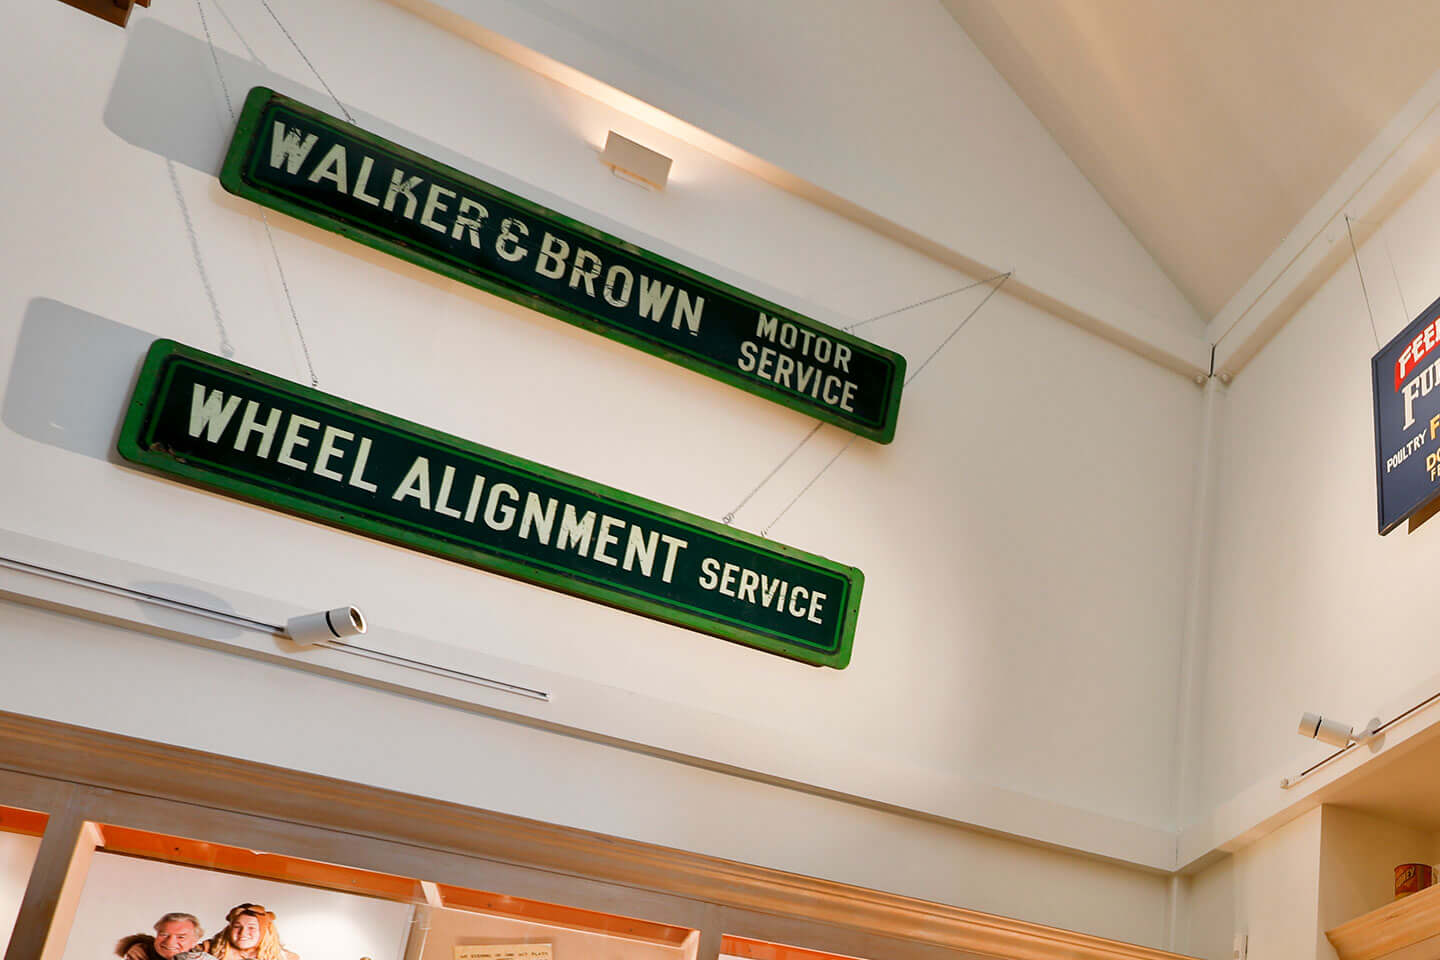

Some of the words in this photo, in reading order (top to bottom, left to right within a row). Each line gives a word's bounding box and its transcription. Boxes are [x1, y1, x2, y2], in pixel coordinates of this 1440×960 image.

[269, 121, 487, 248] WALKER
[494, 217, 529, 263] &
[535, 233, 706, 336] BROWN
[736, 342, 858, 414] SERVICE
[754, 310, 853, 374] MOTOR
[1387, 429, 1428, 473] POULTRY
[188, 383, 379, 496] WHEEL
[392, 456, 688, 585] ALIGNMENT
[698, 558, 827, 626] SERVICE
